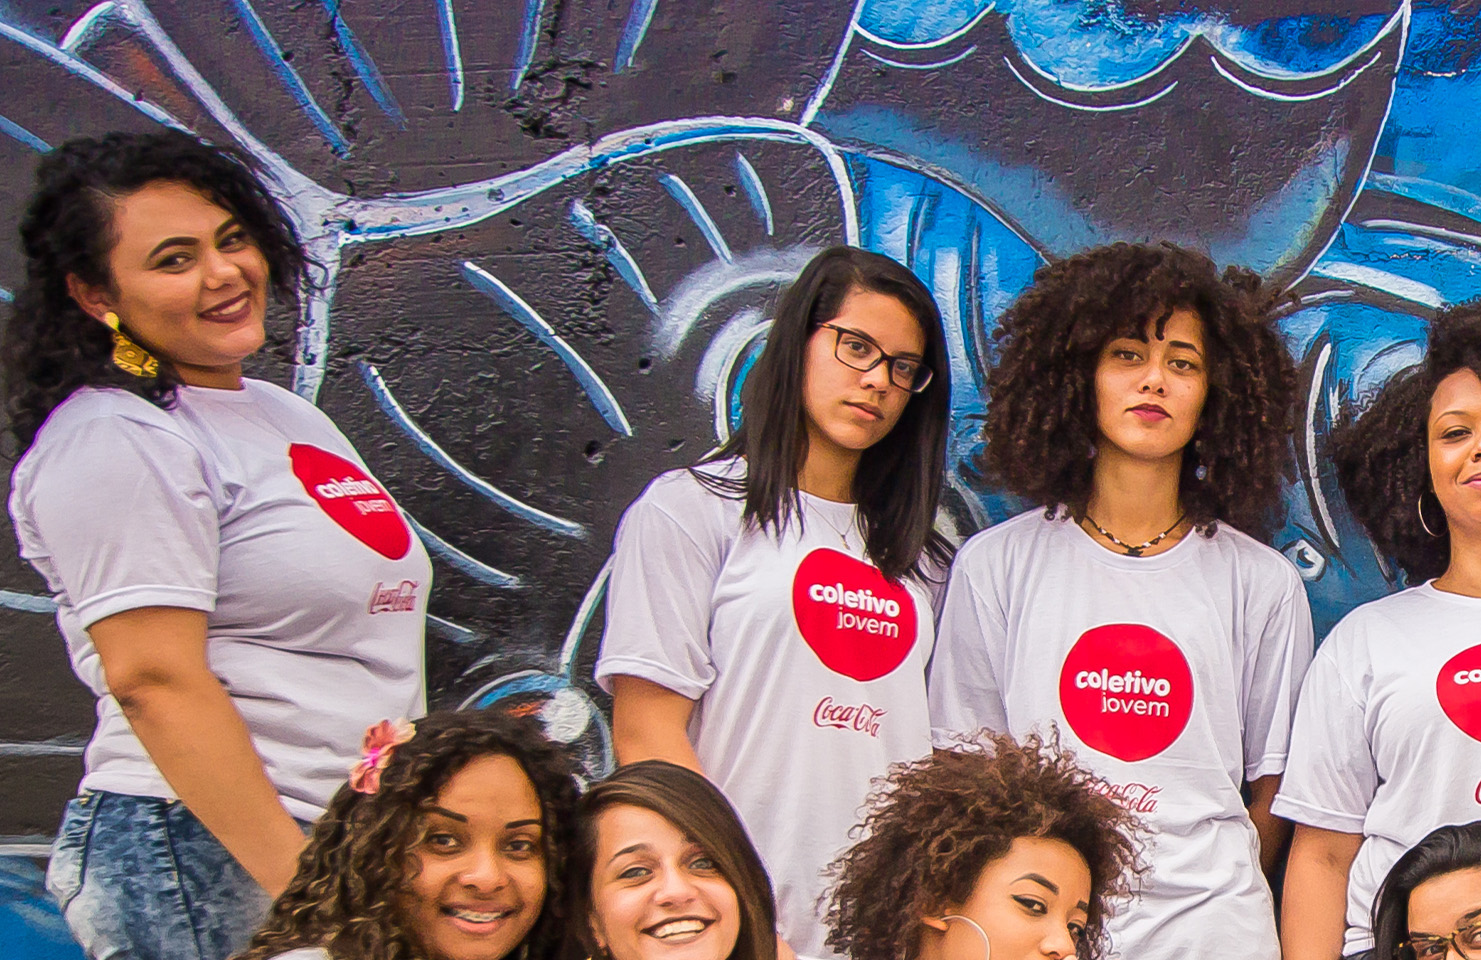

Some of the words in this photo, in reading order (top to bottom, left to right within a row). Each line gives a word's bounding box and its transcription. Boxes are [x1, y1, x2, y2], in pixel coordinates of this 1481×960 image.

[315, 476, 380, 499] coletivo
[349, 497, 396, 516] jovem
[808, 582, 900, 618] coletivo
[836, 606, 900, 638] jovem
[1075, 668, 1171, 697] coletivo
[812, 696, 888, 738] Coca-Cola
[1100, 692, 1170, 717] jovem
